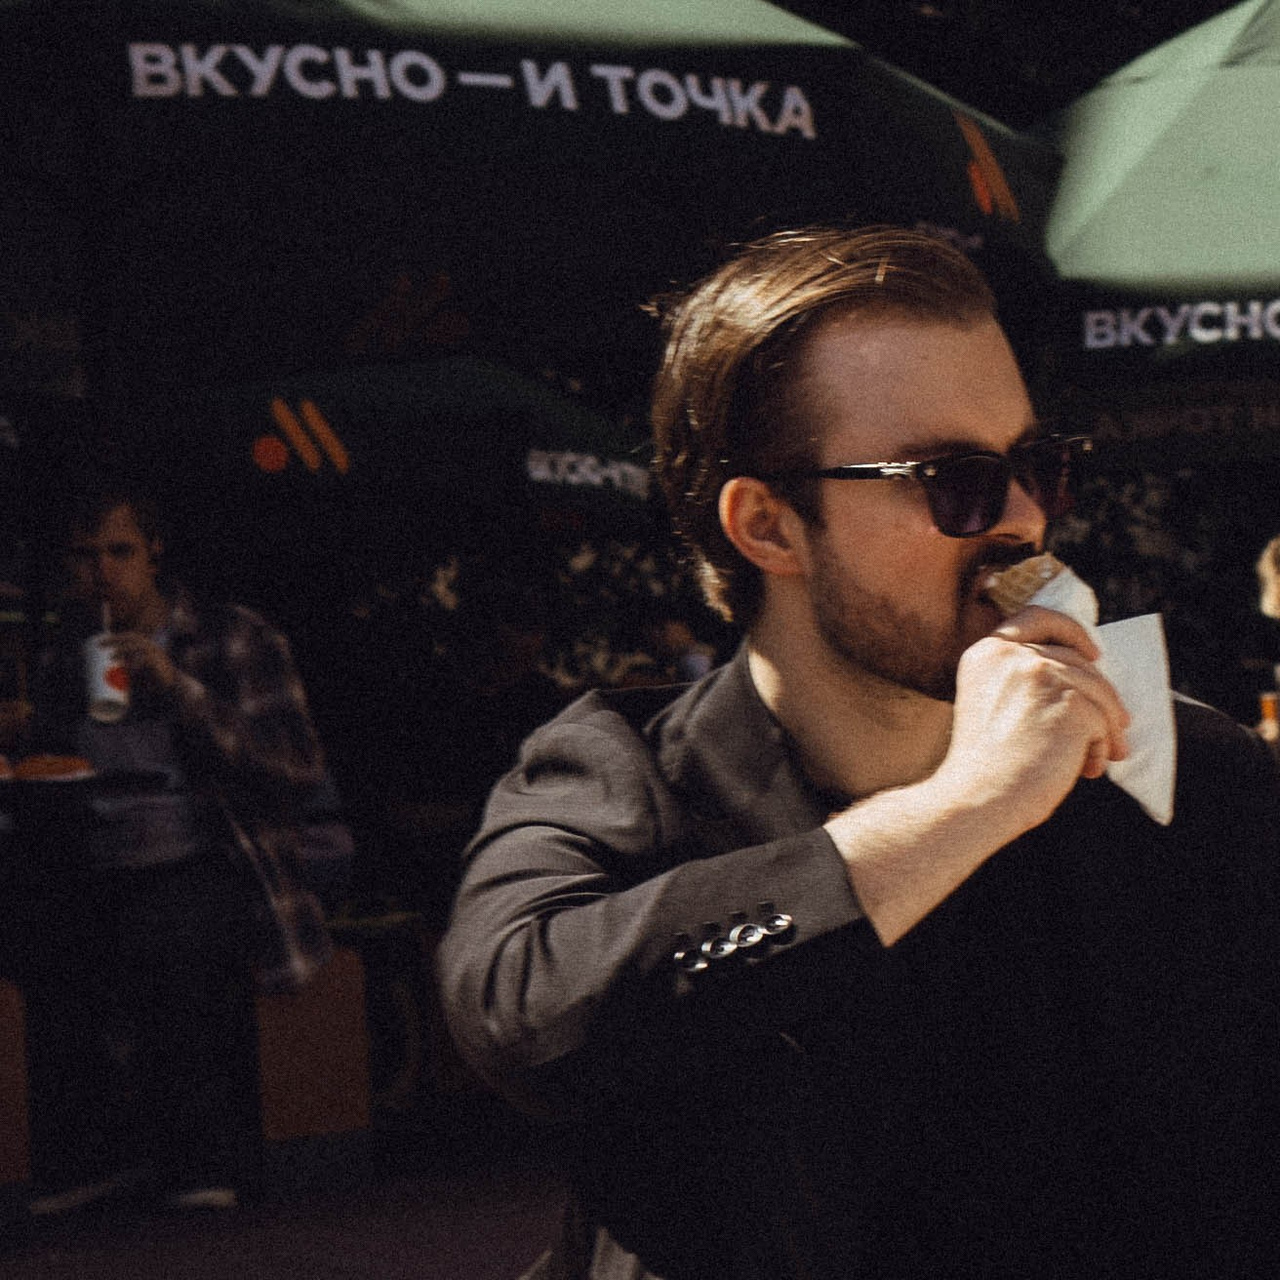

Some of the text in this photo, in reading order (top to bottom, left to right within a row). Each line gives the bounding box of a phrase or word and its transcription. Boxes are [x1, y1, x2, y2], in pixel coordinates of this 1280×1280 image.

[128, 43, 446, 102] ВКУСНО
[521, 59, 578, 111] И
[590, 64, 816, 139] ТОЧКА
